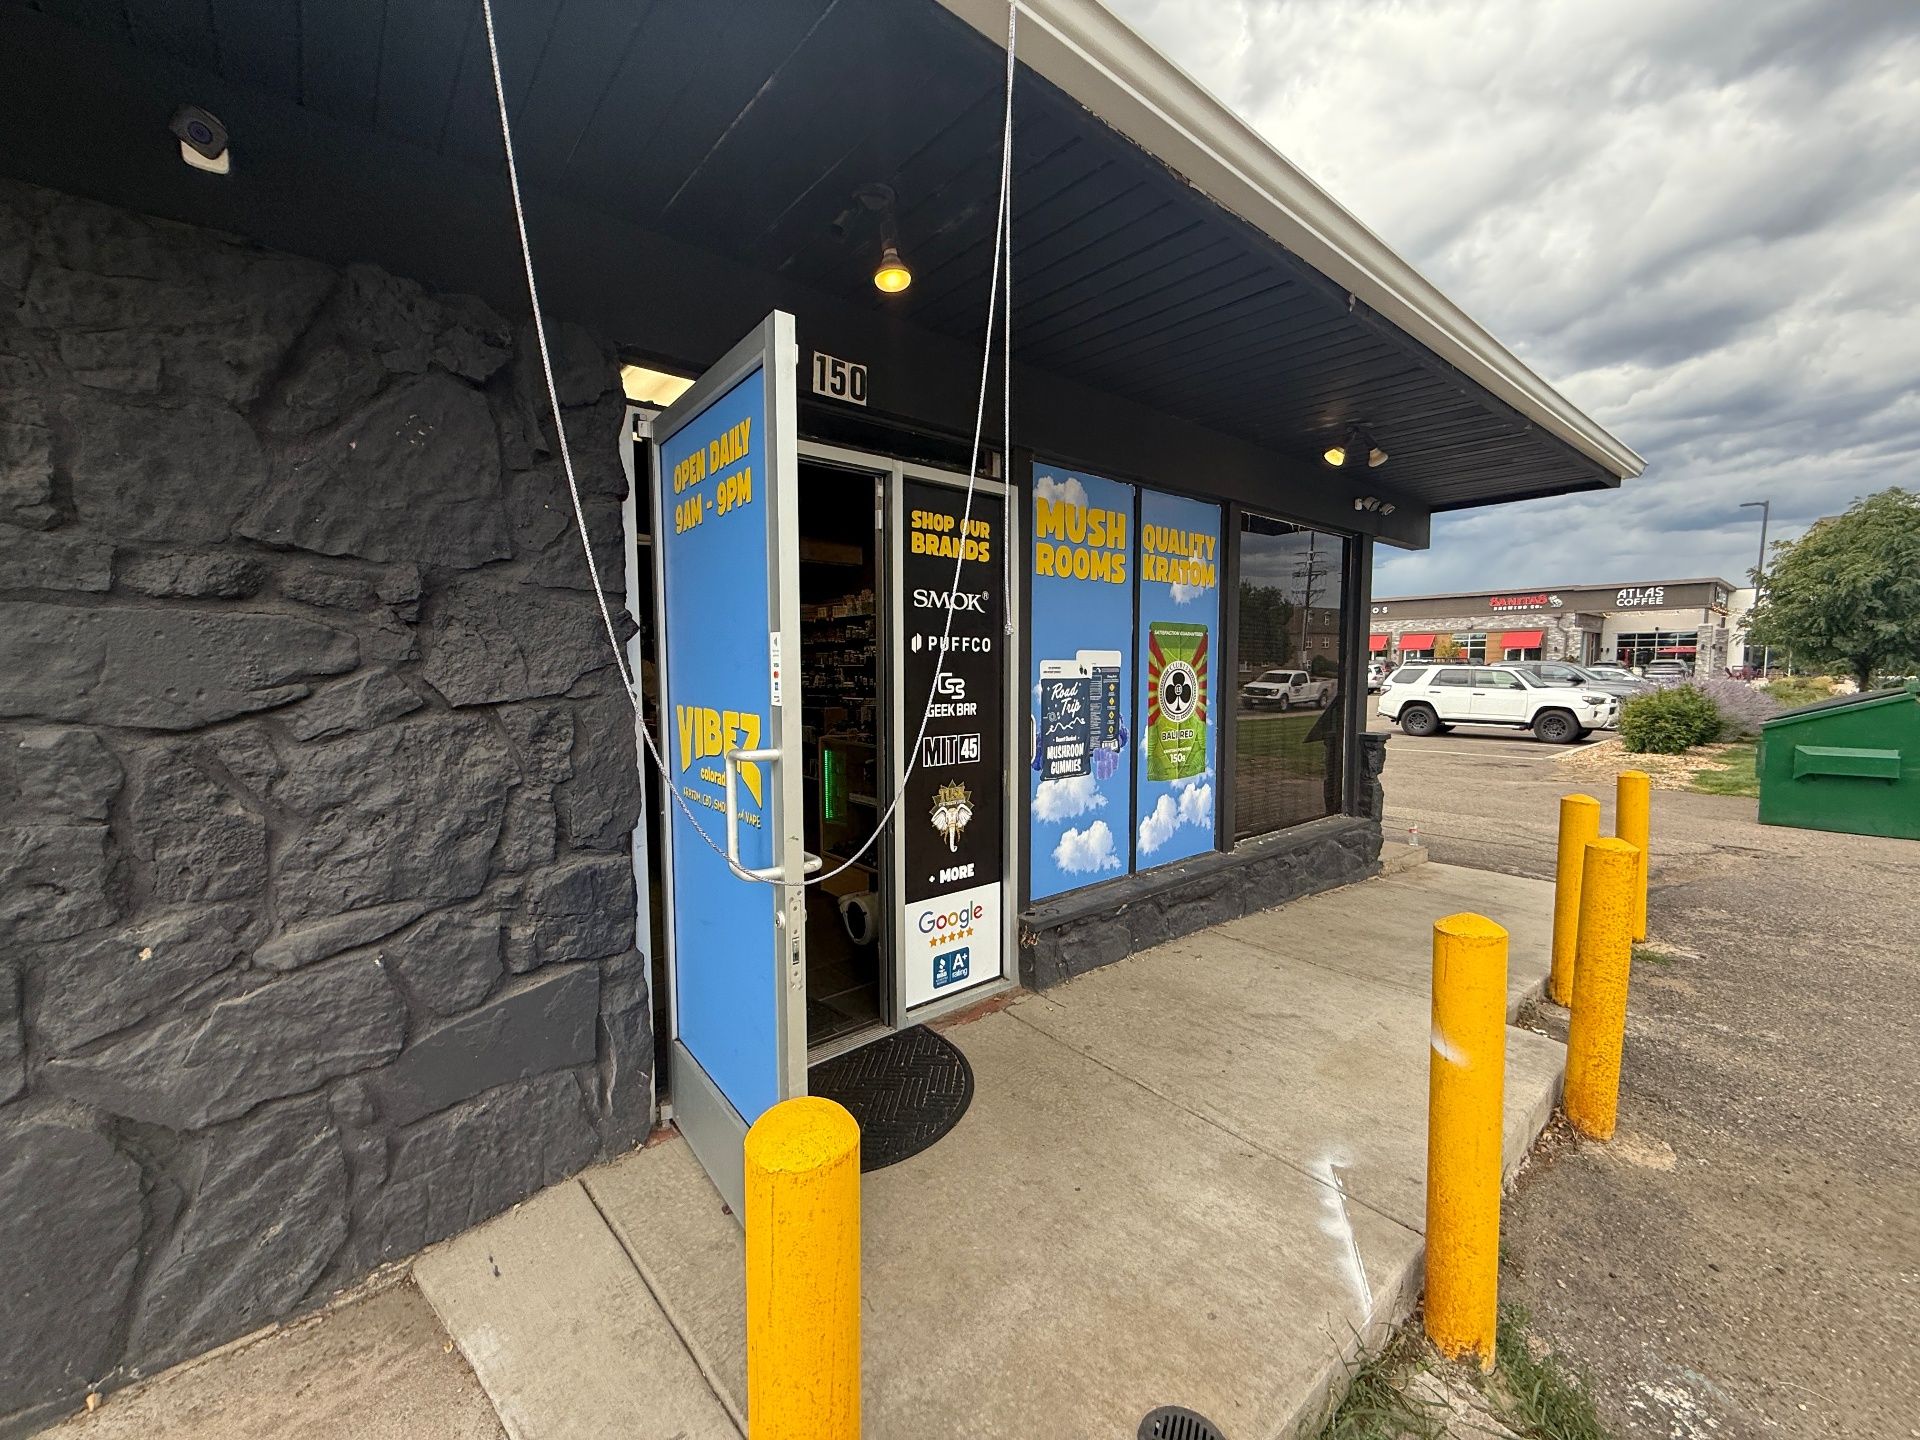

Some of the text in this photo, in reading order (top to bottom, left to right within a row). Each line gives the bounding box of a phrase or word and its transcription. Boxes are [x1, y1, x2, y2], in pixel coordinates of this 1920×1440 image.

[816, 355, 867, 401] 150
[673, 417, 752, 495] OPEN DAILY
[675, 493, 703, 535] 9AM
[716, 467, 752, 517] 9PM
[911, 510, 990, 539] SHOP OUR
[1036, 496, 1126, 550] MUSH
[911, 531, 990, 562] BRANDS
[1142, 524, 1216, 561] QUALITY
[1035, 542, 1126, 585] ROOMS
[1142, 553, 1215, 588] KRATOM
[1489, 594, 1548, 606] SANITAS
[1616, 597, 1664, 607] COFFEE
[1617, 586, 1665, 599] ATLAS
[928, 635, 991, 652] PUFFCO
[1051, 681, 1079, 701] Road
[928, 702, 977, 717] GEEK BAR
[1060, 697, 1082, 718] Trip
[1180, 729, 1194, 739] RED
[676, 704, 763, 809] VIBEZ
[923, 735, 978, 767] MIT 45
[1046, 742, 1085, 760] MUSHROOM
[700, 766, 728, 787] colorad
[1051, 758, 1082, 774] GUMMIES
[745, 811, 762, 829] VAPE
[939, 863, 975, 884] MORE
[918, 900, 983, 934] Google
[952, 953, 968, 970] A+
